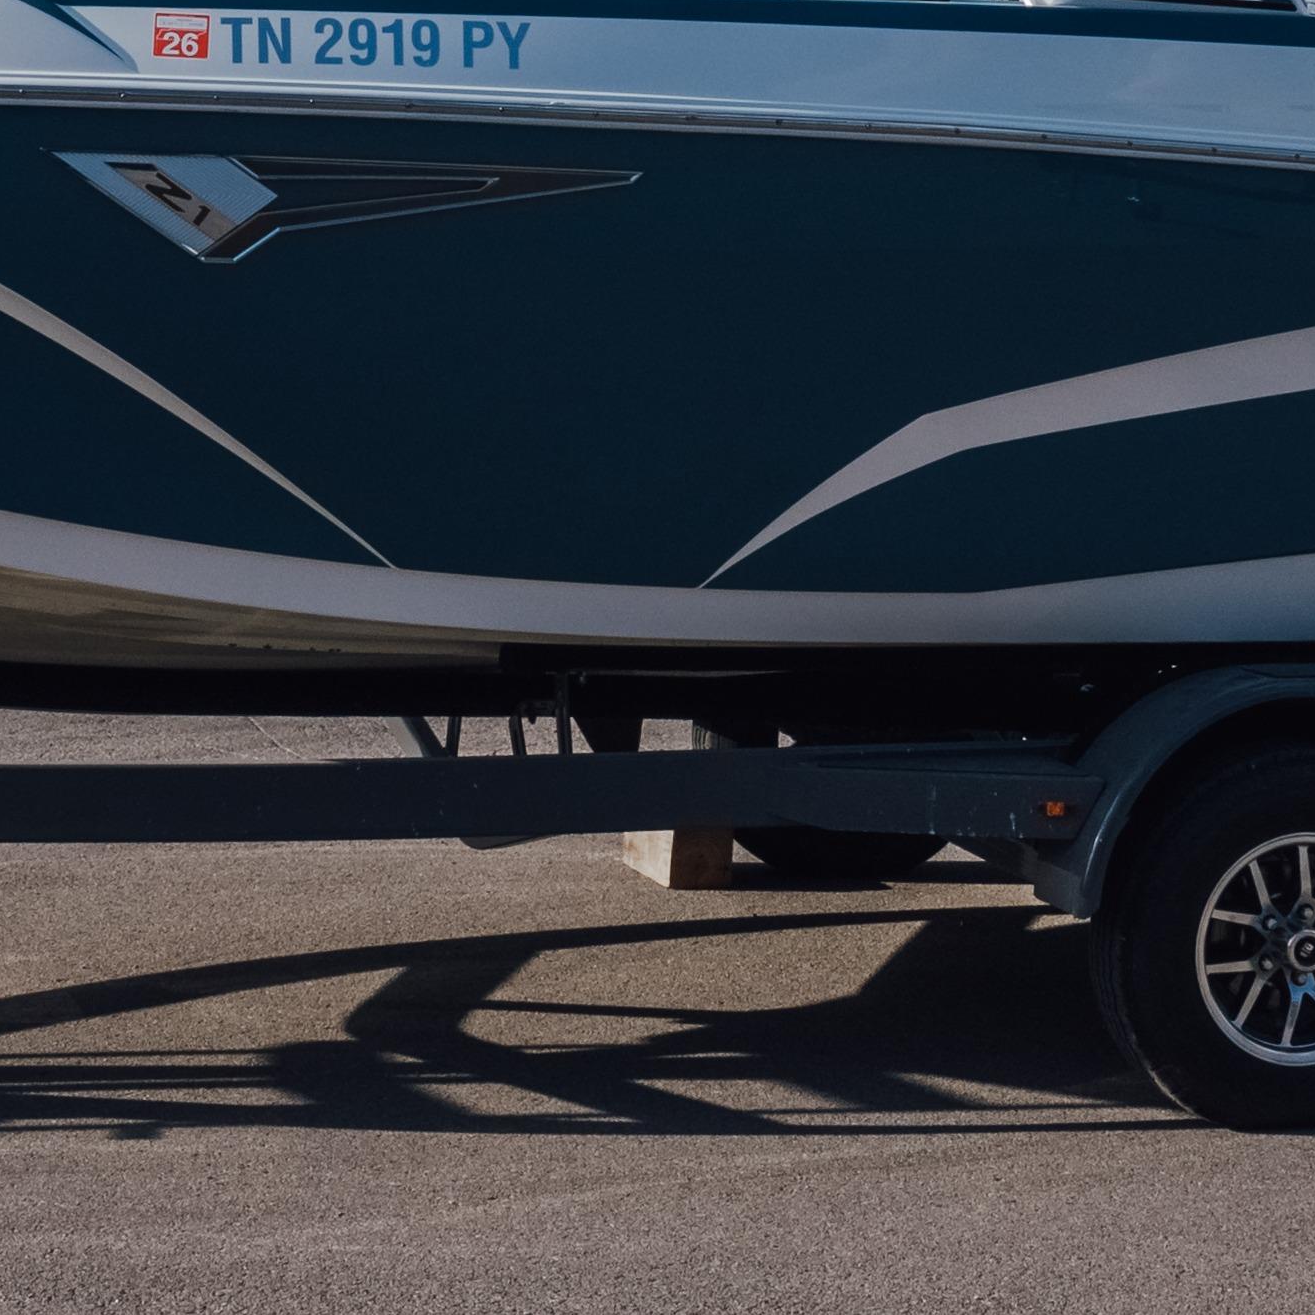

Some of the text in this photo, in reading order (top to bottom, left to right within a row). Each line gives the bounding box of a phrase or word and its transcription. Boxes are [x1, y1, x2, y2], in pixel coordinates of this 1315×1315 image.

[162, 31, 199, 57] 26
[220, 17, 532, 70] TN 2919 PY
